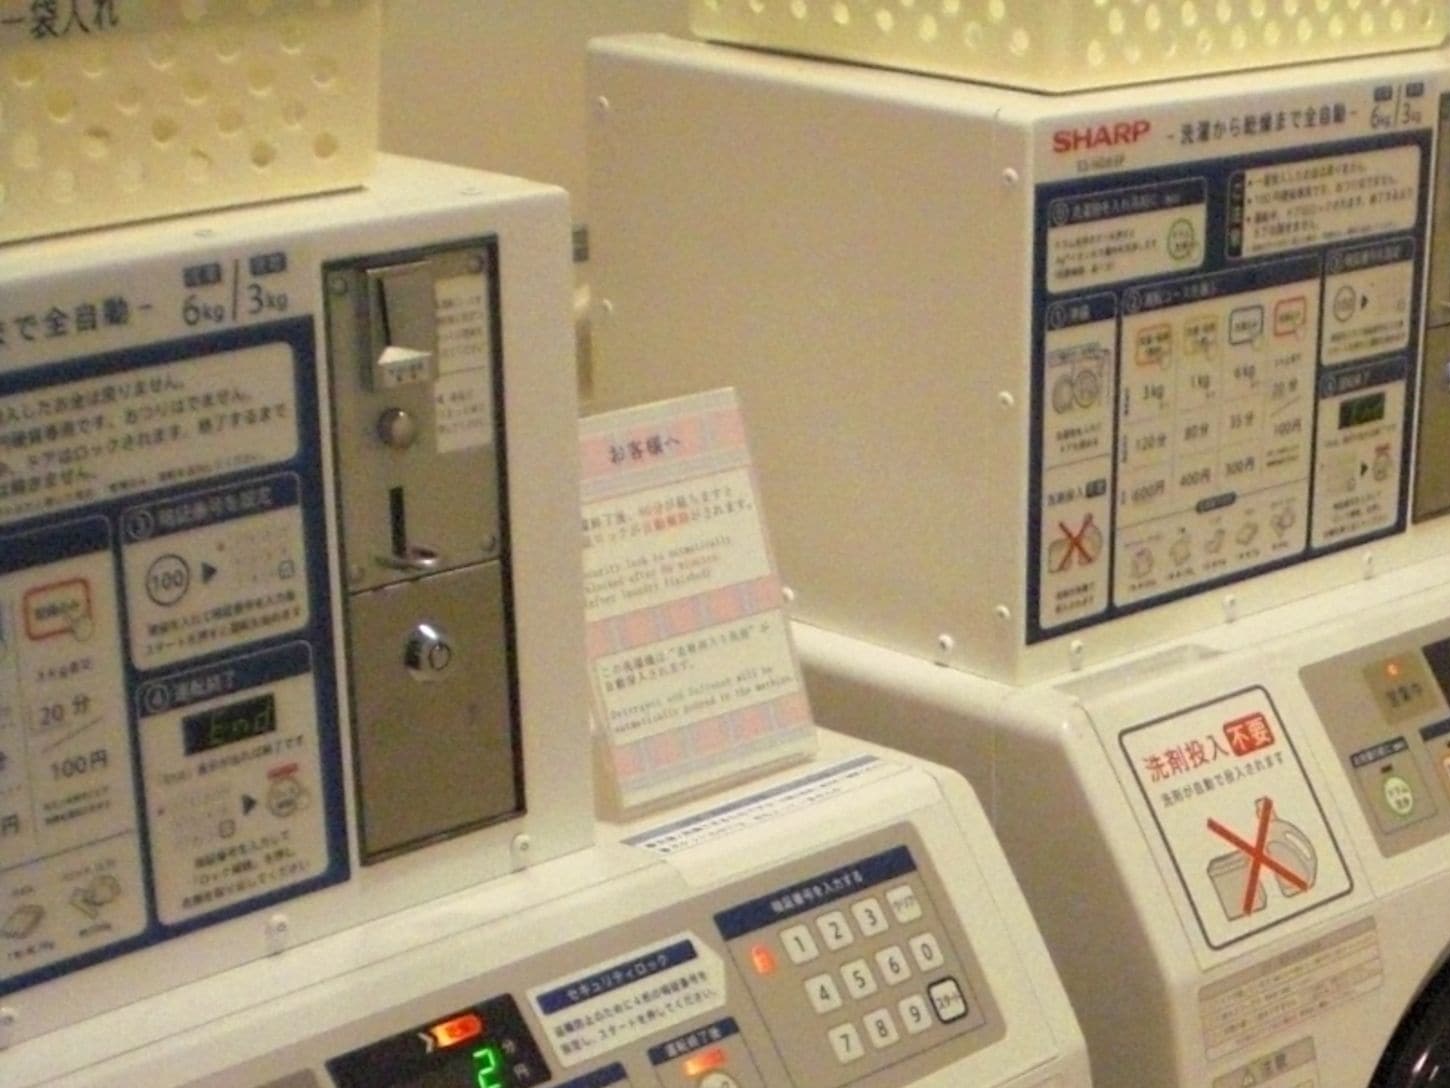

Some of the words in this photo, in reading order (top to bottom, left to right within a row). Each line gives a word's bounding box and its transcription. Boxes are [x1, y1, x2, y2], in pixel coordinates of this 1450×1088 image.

[1052, 120, 1150, 153] SHARP
[183, 295, 223, 326] 6kg
[248, 283, 288, 314] 3kg
[1142, 733, 1230, 784] 洗剤投入
[1230, 714, 1274, 748] 不要
[51, 748, 108, 782] 100円
[862, 907, 879, 926] 3
[827, 920, 844, 940] 2
[792, 935, 806, 953] 1
[918, 942, 936, 961] 0
[885, 955, 902, 975] 6
[565, 953, 670, 1002] セキュリティロック
[851, 969, 867, 989] 5
[814, 983, 831, 1003] 4
[906, 1004, 924, 1024] 9
[873, 1018, 890, 1038] 8
[839, 1032, 856, 1053] 7
